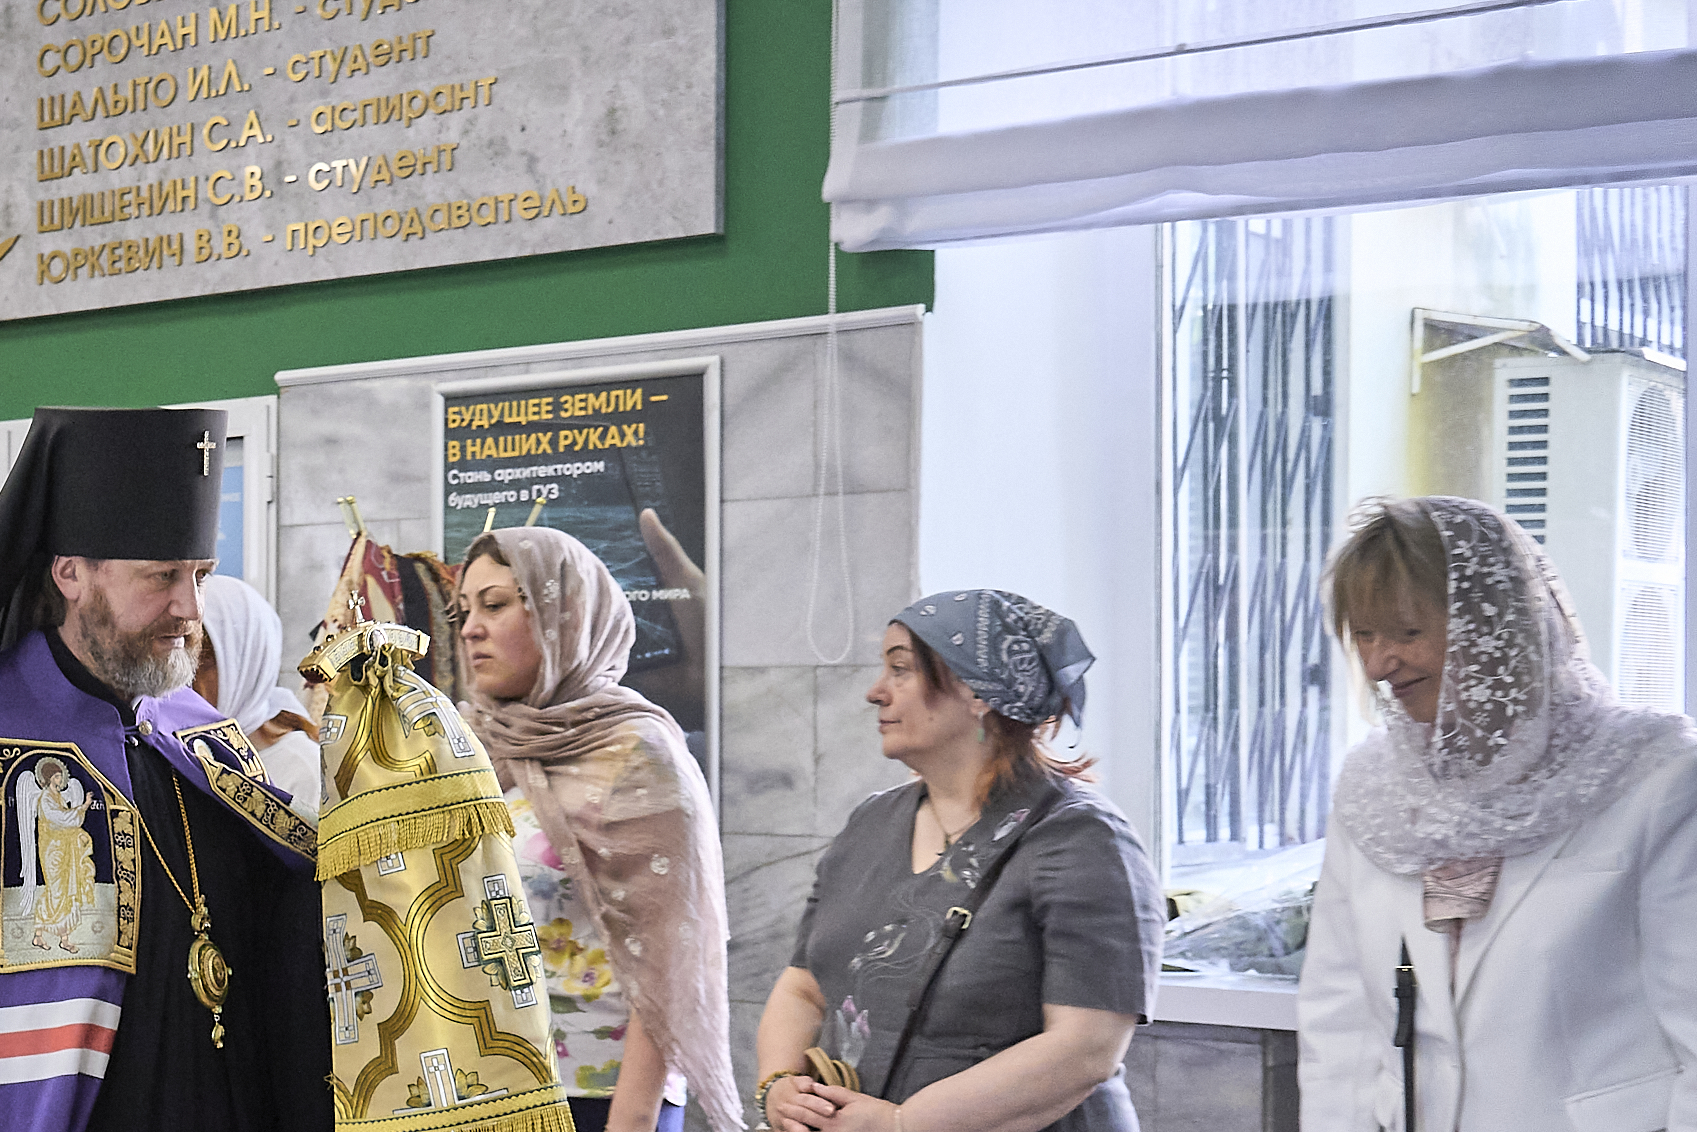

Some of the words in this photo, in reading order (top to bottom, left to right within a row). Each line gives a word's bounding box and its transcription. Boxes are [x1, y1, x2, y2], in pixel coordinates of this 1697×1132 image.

[36, 12, 198, 78] СОРОЧАН
[208, 0, 281, 43] М.Н.
[36, 71, 177, 130] ШАЛЫТО
[187, 58, 251, 102] И.Л.
[286, 29, 435, 83] студент
[36, 122, 194, 182] ШАТОХИН
[203, 109, 274, 152] С.А.
[310, 76, 498, 134] аспирант
[36, 175, 198, 233] ШИШЕНИН
[207, 165, 273, 206] С.В.
[308, 142, 459, 194] студент
[36, 231, 183, 286] ЮРКЕВИЧ
[194, 223, 250, 263] В.В.
[286, 185, 588, 256] преподаватель
[447, 397, 554, 430] БУДУЩЕЕ
[559, 388, 644, 419] ЗЕМЛИ
[447, 441, 461, 463] В
[465, 431, 553, 461] НАШИХ
[558, 422, 645, 452] РУКАХ!
[447, 468, 492, 486] Стань
[493, 460, 605, 484] архитектором
[447, 491, 518, 510] будущего
[519, 489, 529, 502] в
[531, 483, 560, 502] ГУЗ
[624, 590, 650, 601] ОГО
